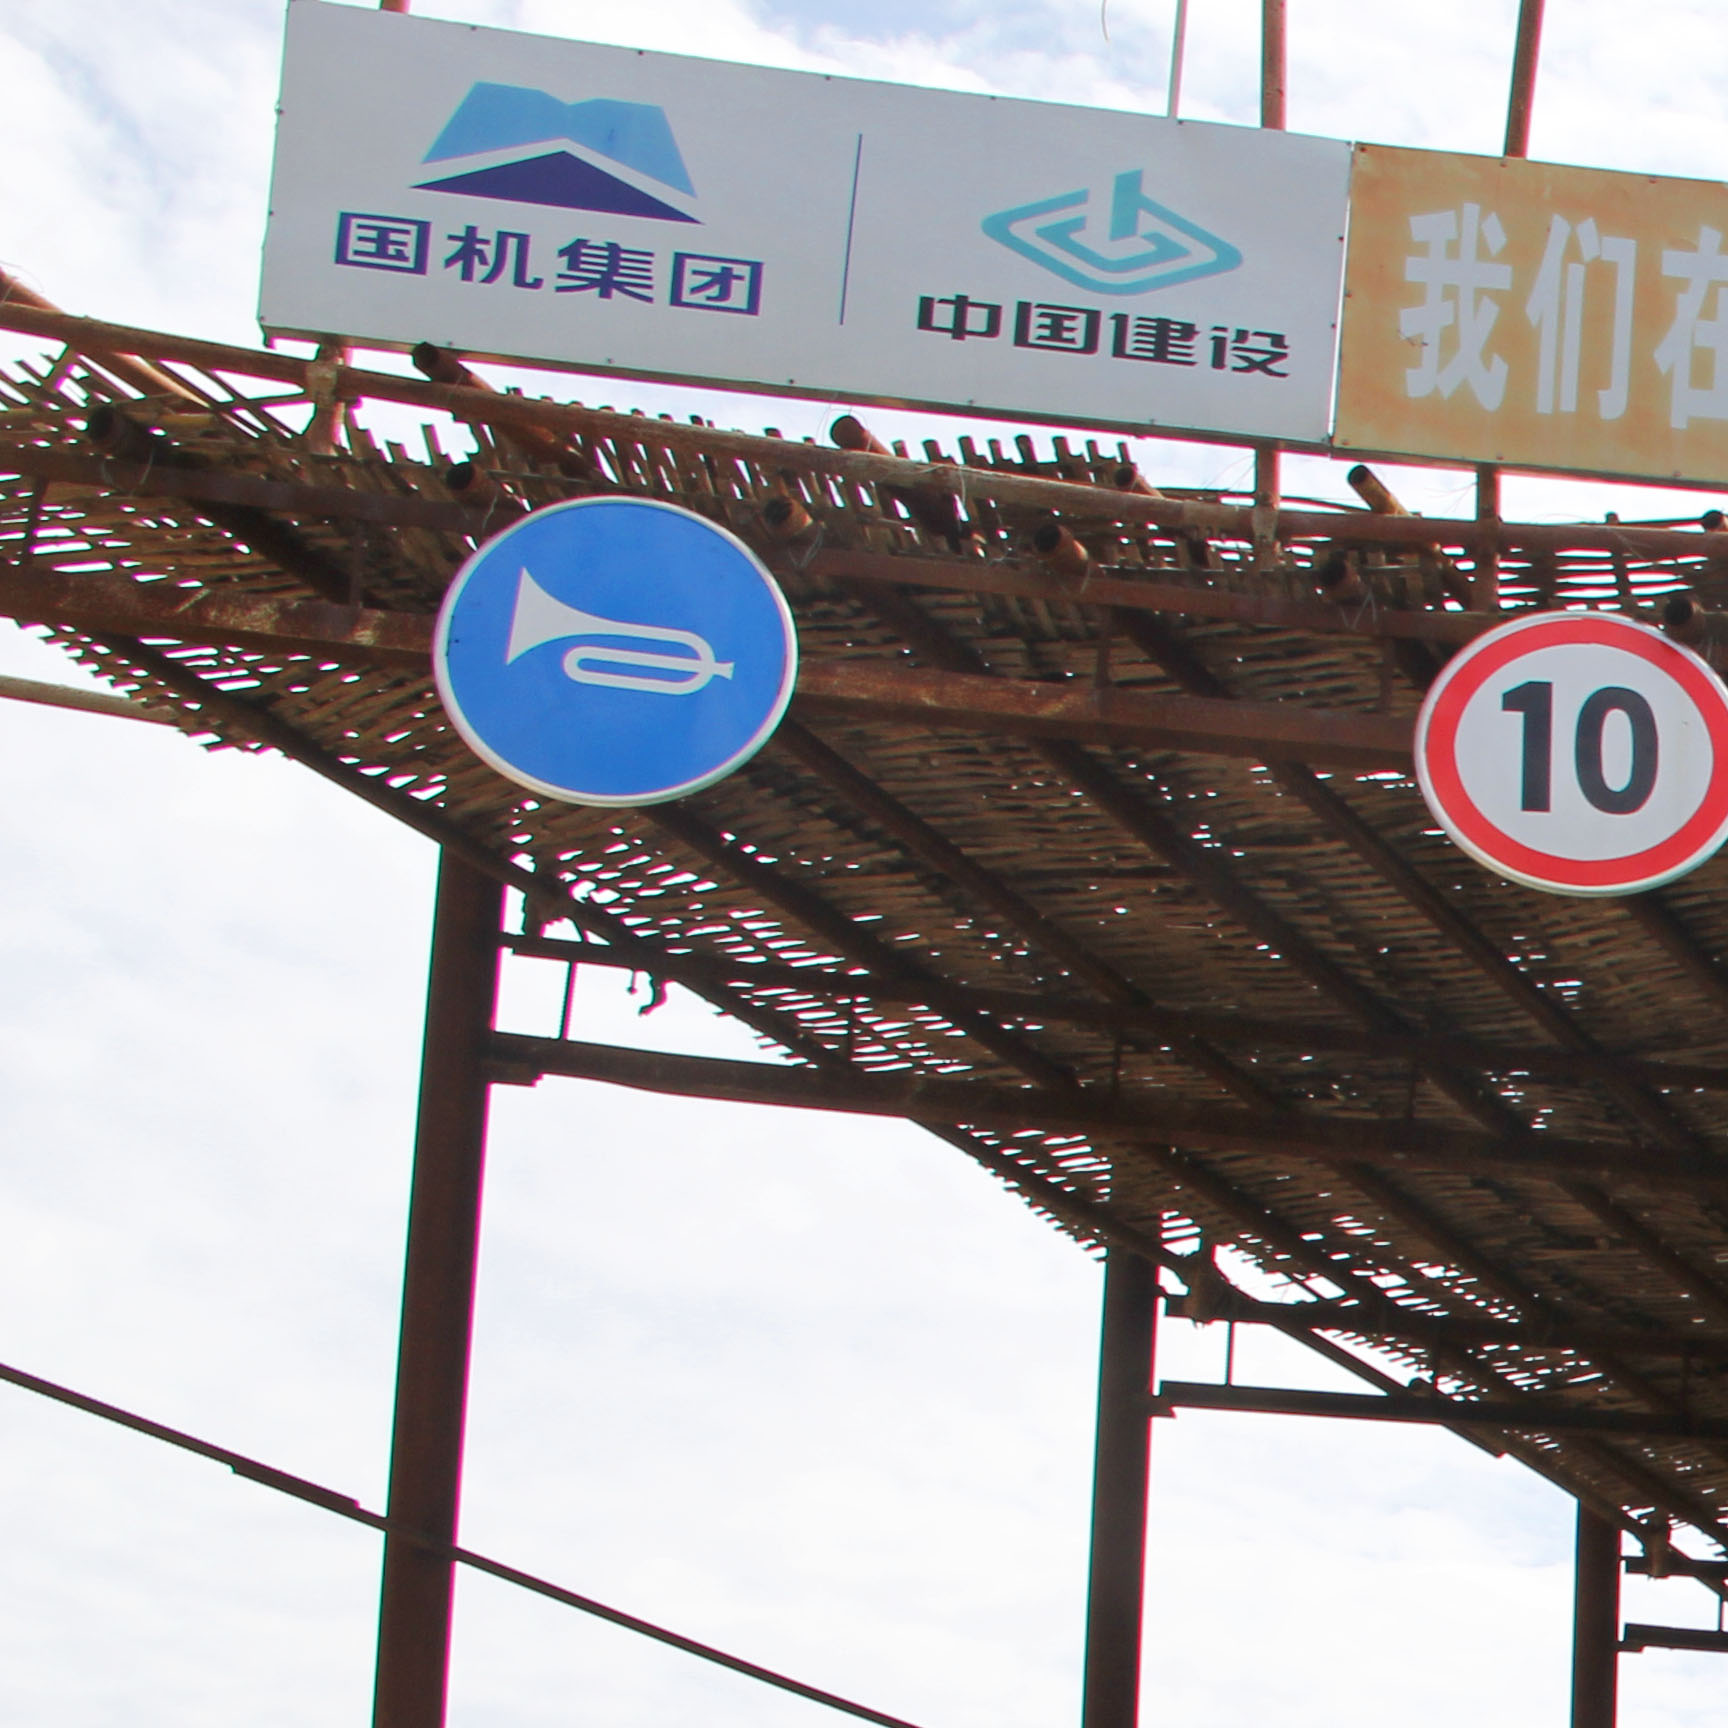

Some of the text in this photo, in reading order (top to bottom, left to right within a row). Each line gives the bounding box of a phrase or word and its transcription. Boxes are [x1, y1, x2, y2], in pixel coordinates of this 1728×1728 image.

[334, 211, 765, 318] 国机集团
[916, 294, 1292, 379] 中国建设
[1501, 681, 1659, 815] 10
